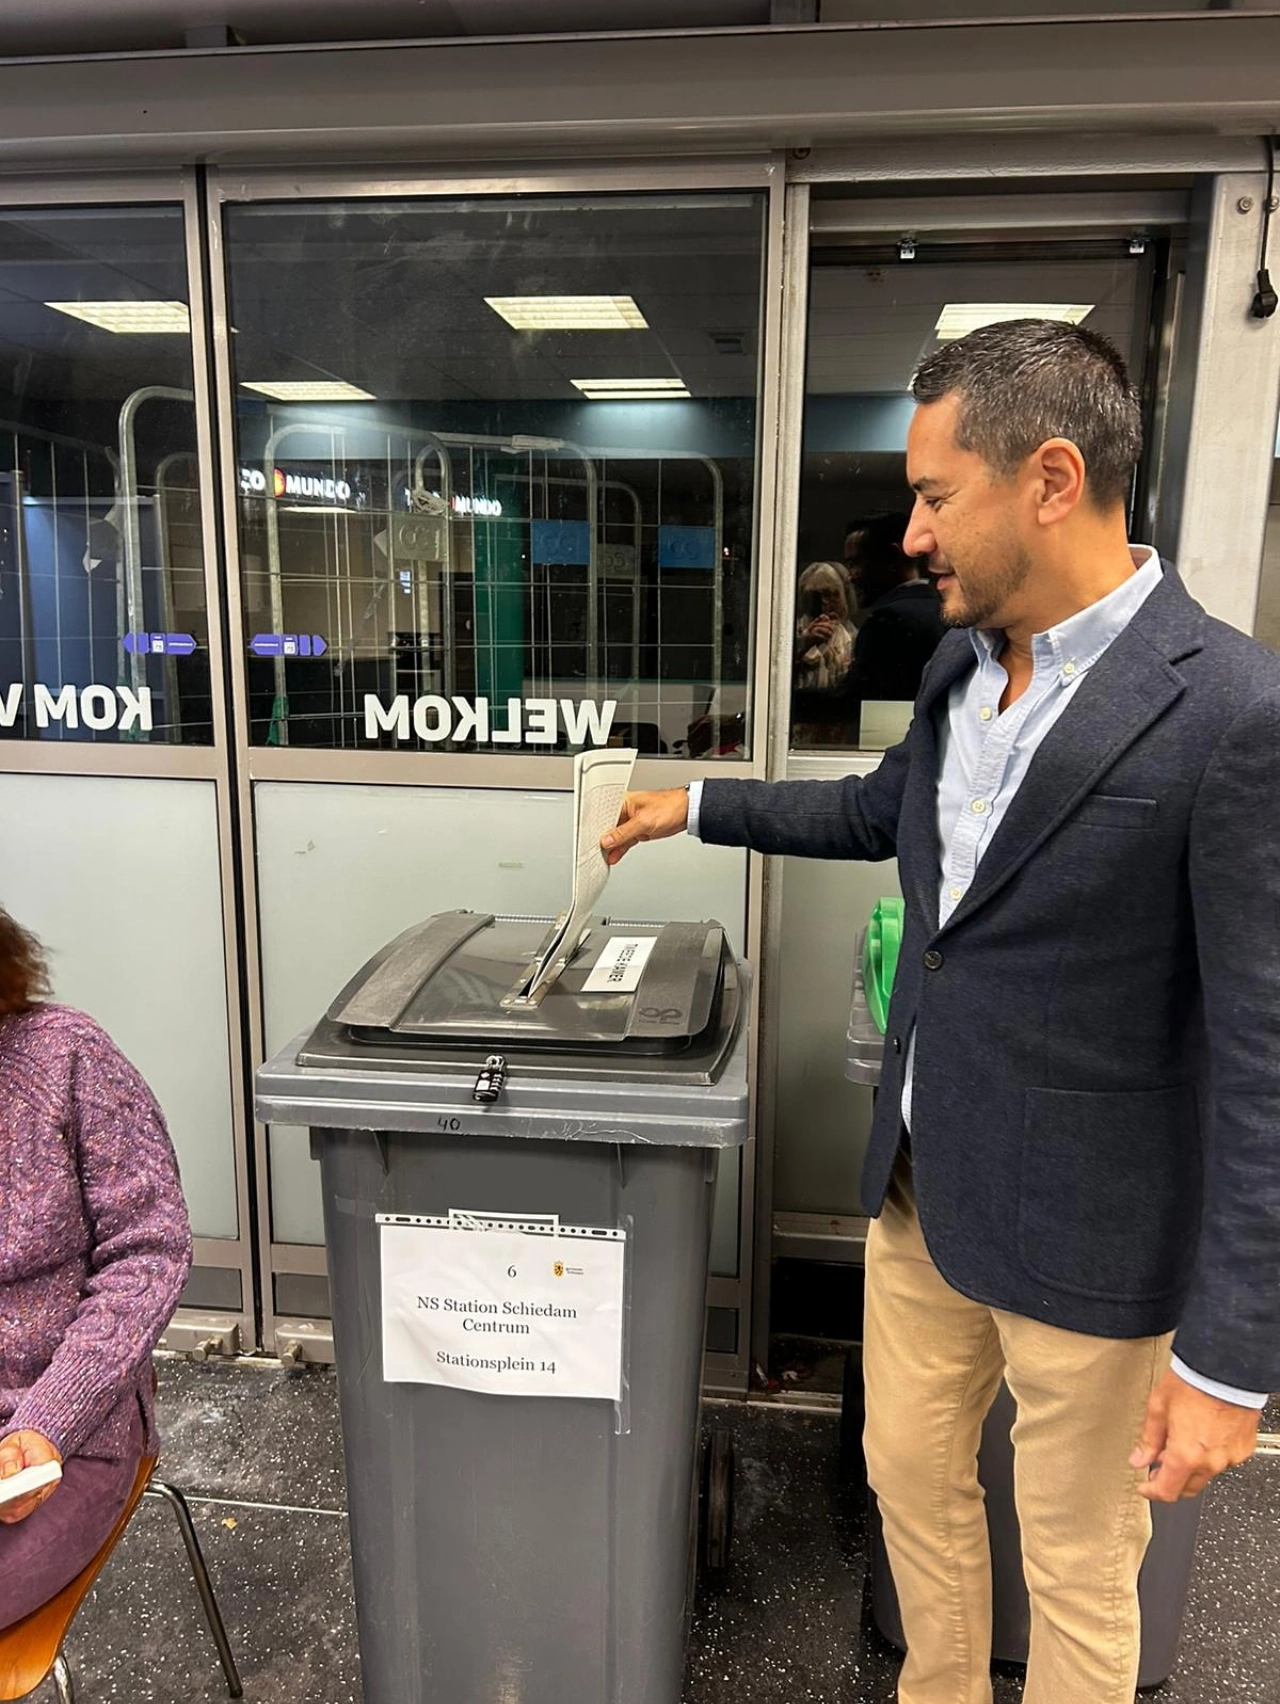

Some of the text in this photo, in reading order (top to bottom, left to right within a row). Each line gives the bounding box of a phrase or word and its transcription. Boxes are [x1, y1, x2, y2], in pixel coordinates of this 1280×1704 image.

[286, 475, 351, 500] MUNDO
[437, 1115, 461, 1131] 40
[507, 1264, 517, 1278] 6
[417, 1296, 578, 1319] NS Station Schiedam
[462, 1317, 530, 1334] Centrum
[436, 1350, 556, 1374] Stationsplein 14
